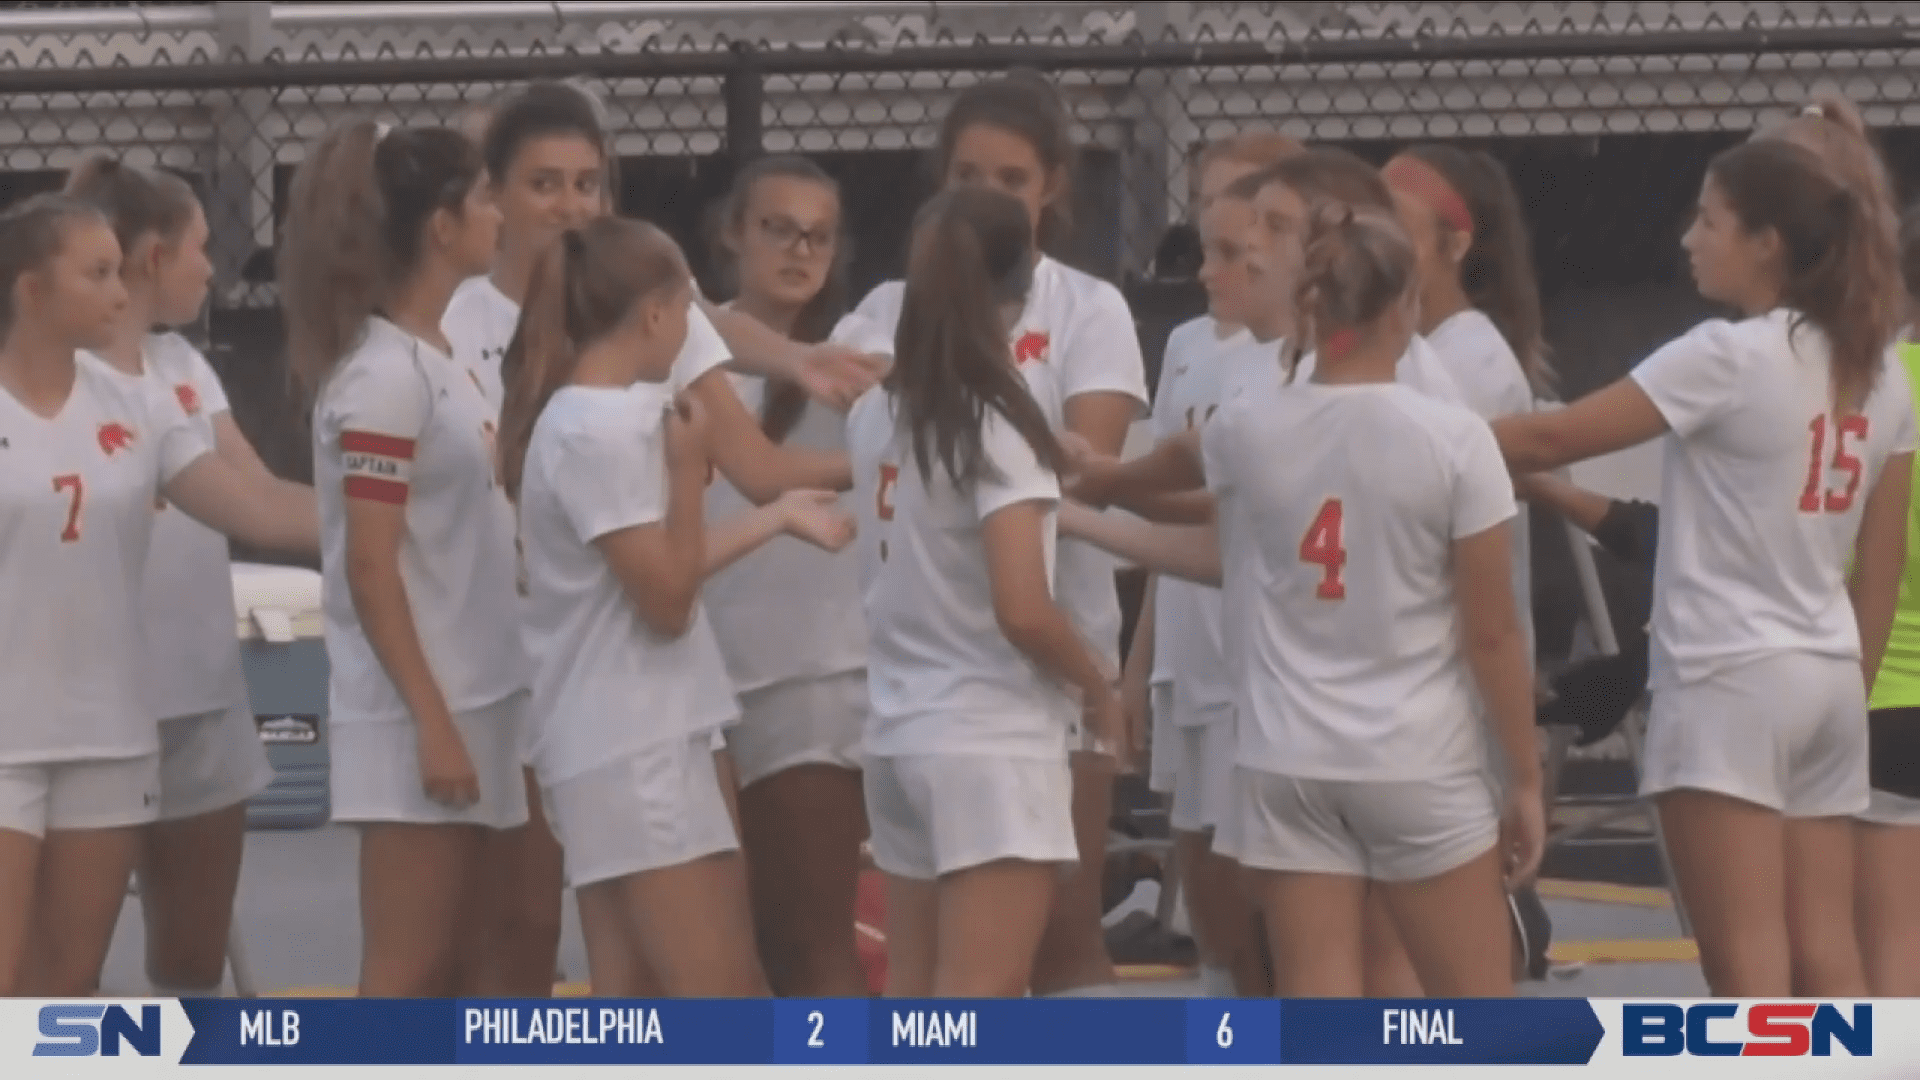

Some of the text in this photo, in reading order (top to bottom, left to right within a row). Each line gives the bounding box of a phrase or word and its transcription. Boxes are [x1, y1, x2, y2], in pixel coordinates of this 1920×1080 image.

[53, 475, 83, 542] 7
[1799, 413, 1869, 513] 15
[1300, 498, 1346, 600] 4
